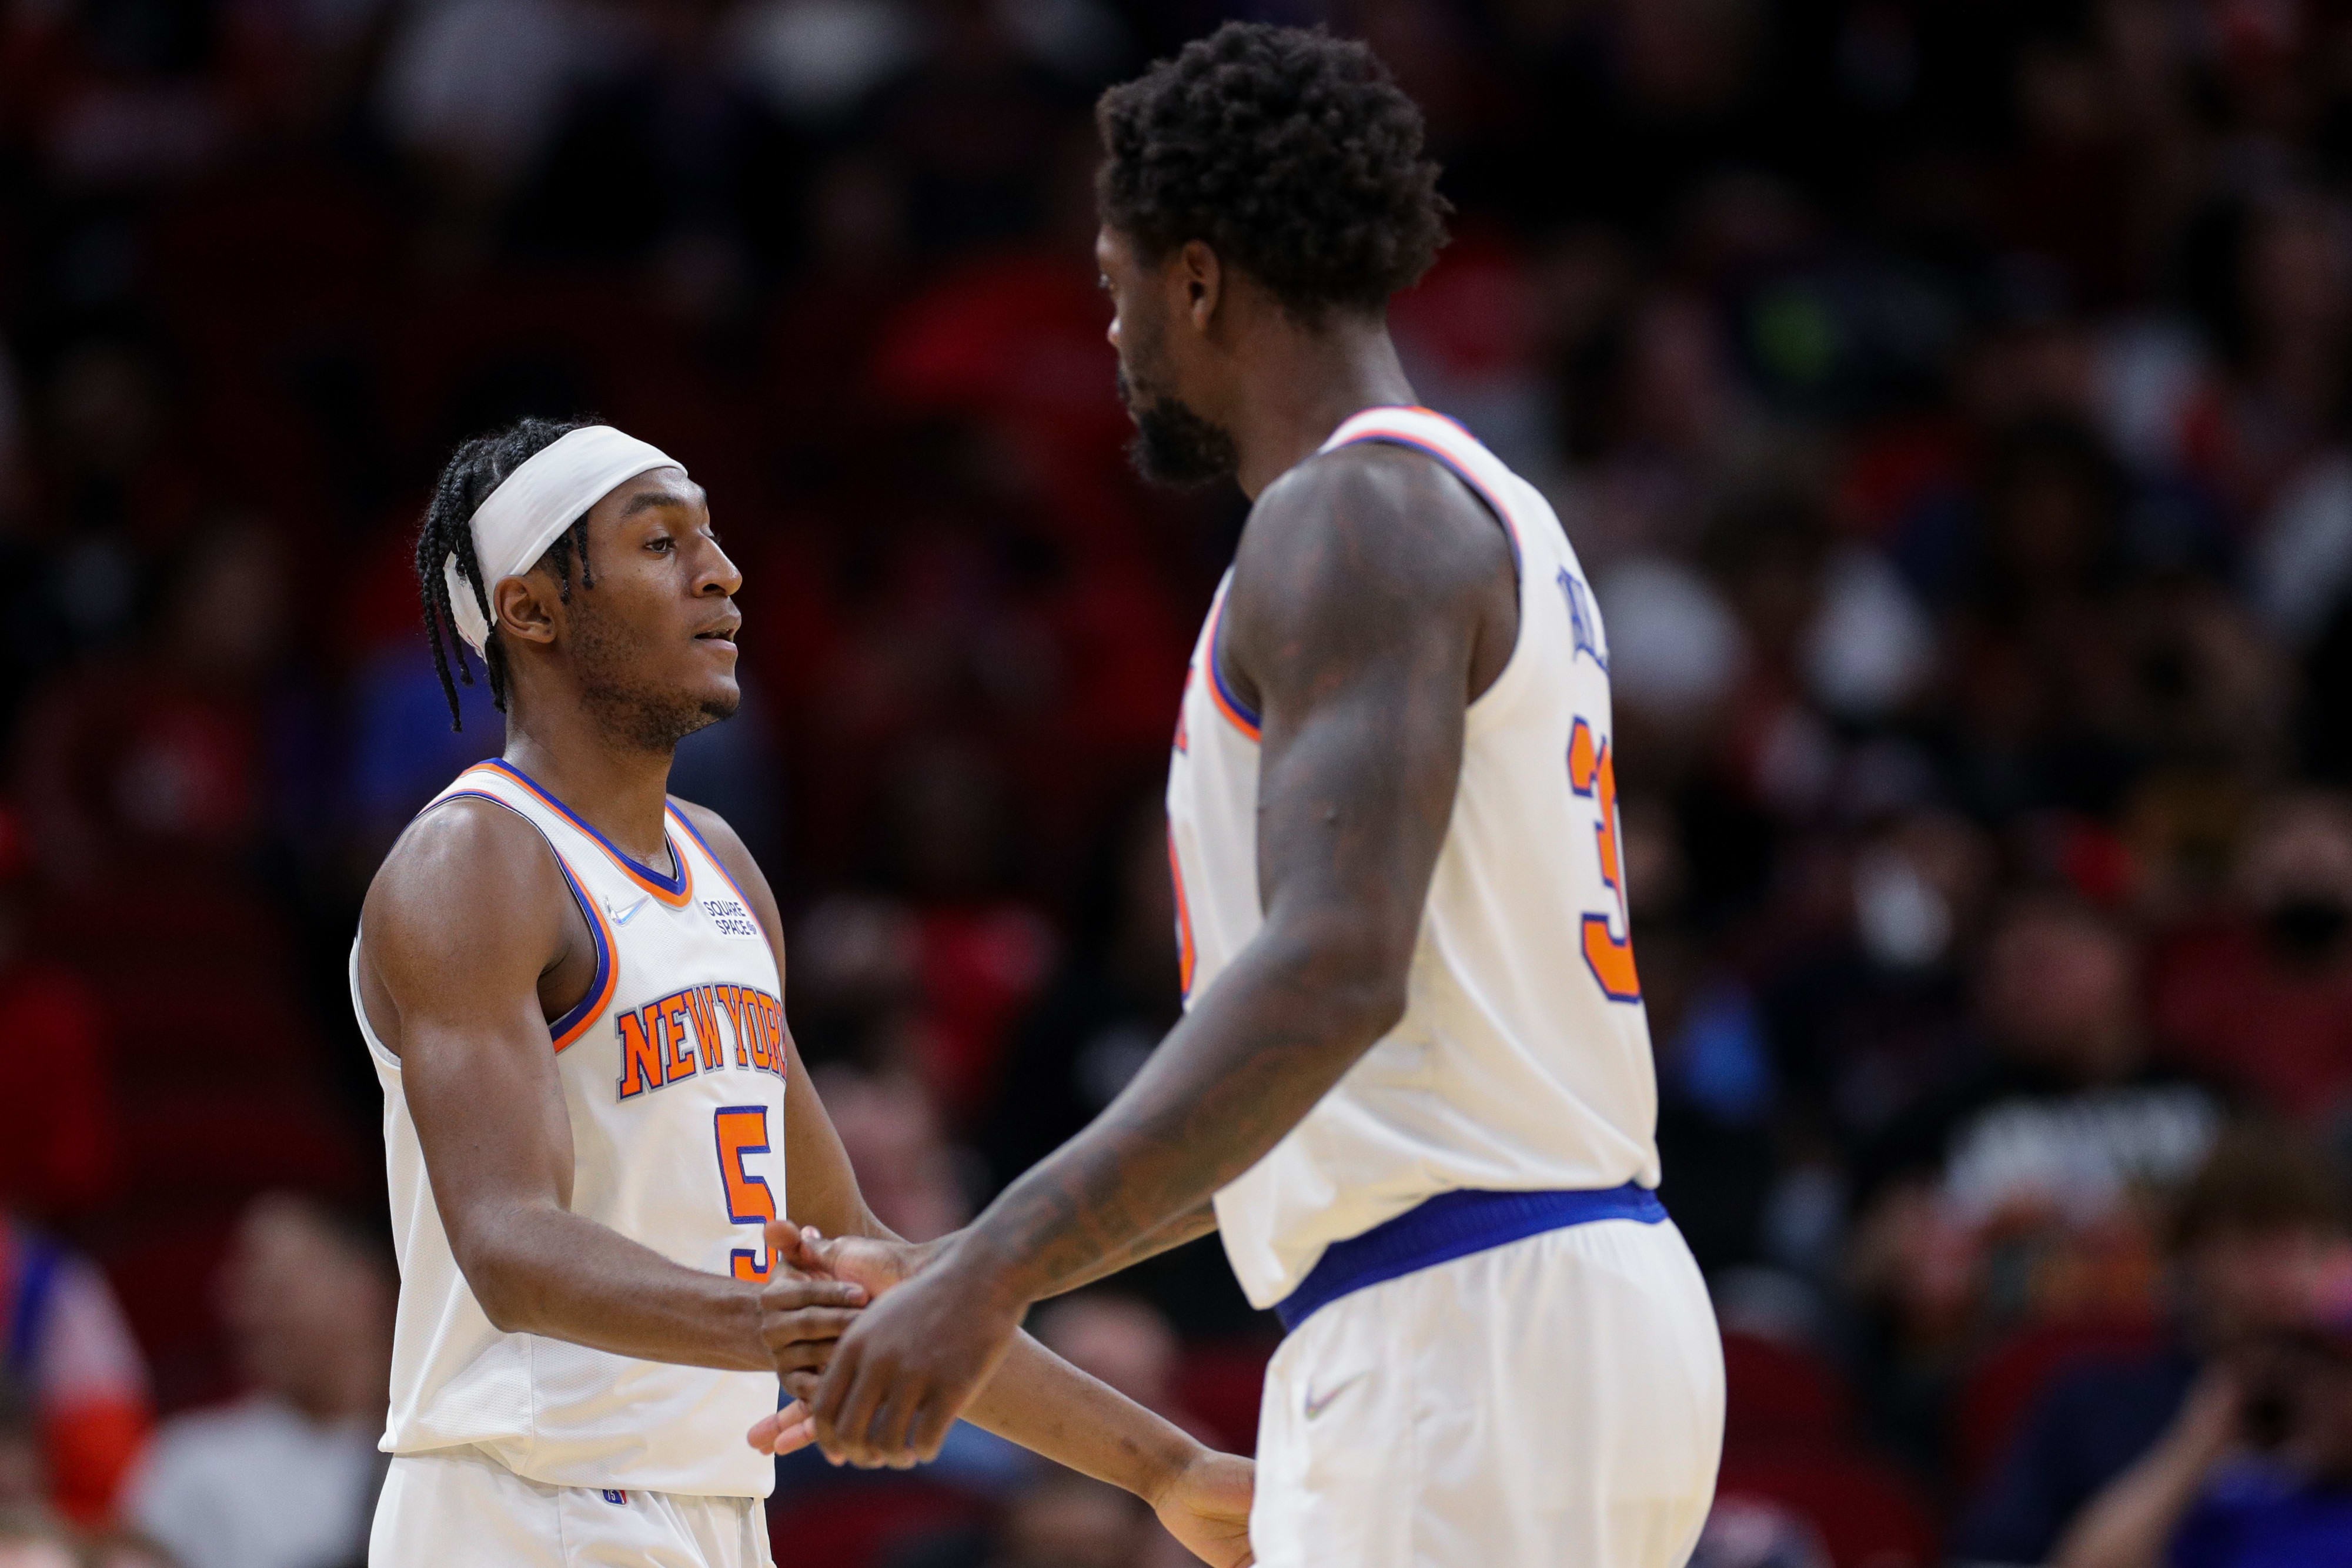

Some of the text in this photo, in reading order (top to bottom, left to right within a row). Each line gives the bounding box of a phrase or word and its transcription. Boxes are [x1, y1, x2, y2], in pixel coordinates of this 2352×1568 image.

[703, 900, 746, 917] SQUARE
[716, 919, 750, 935] SPACE
[614, 982, 724, 1104] NEW
[714, 1105, 778, 1283] 5
